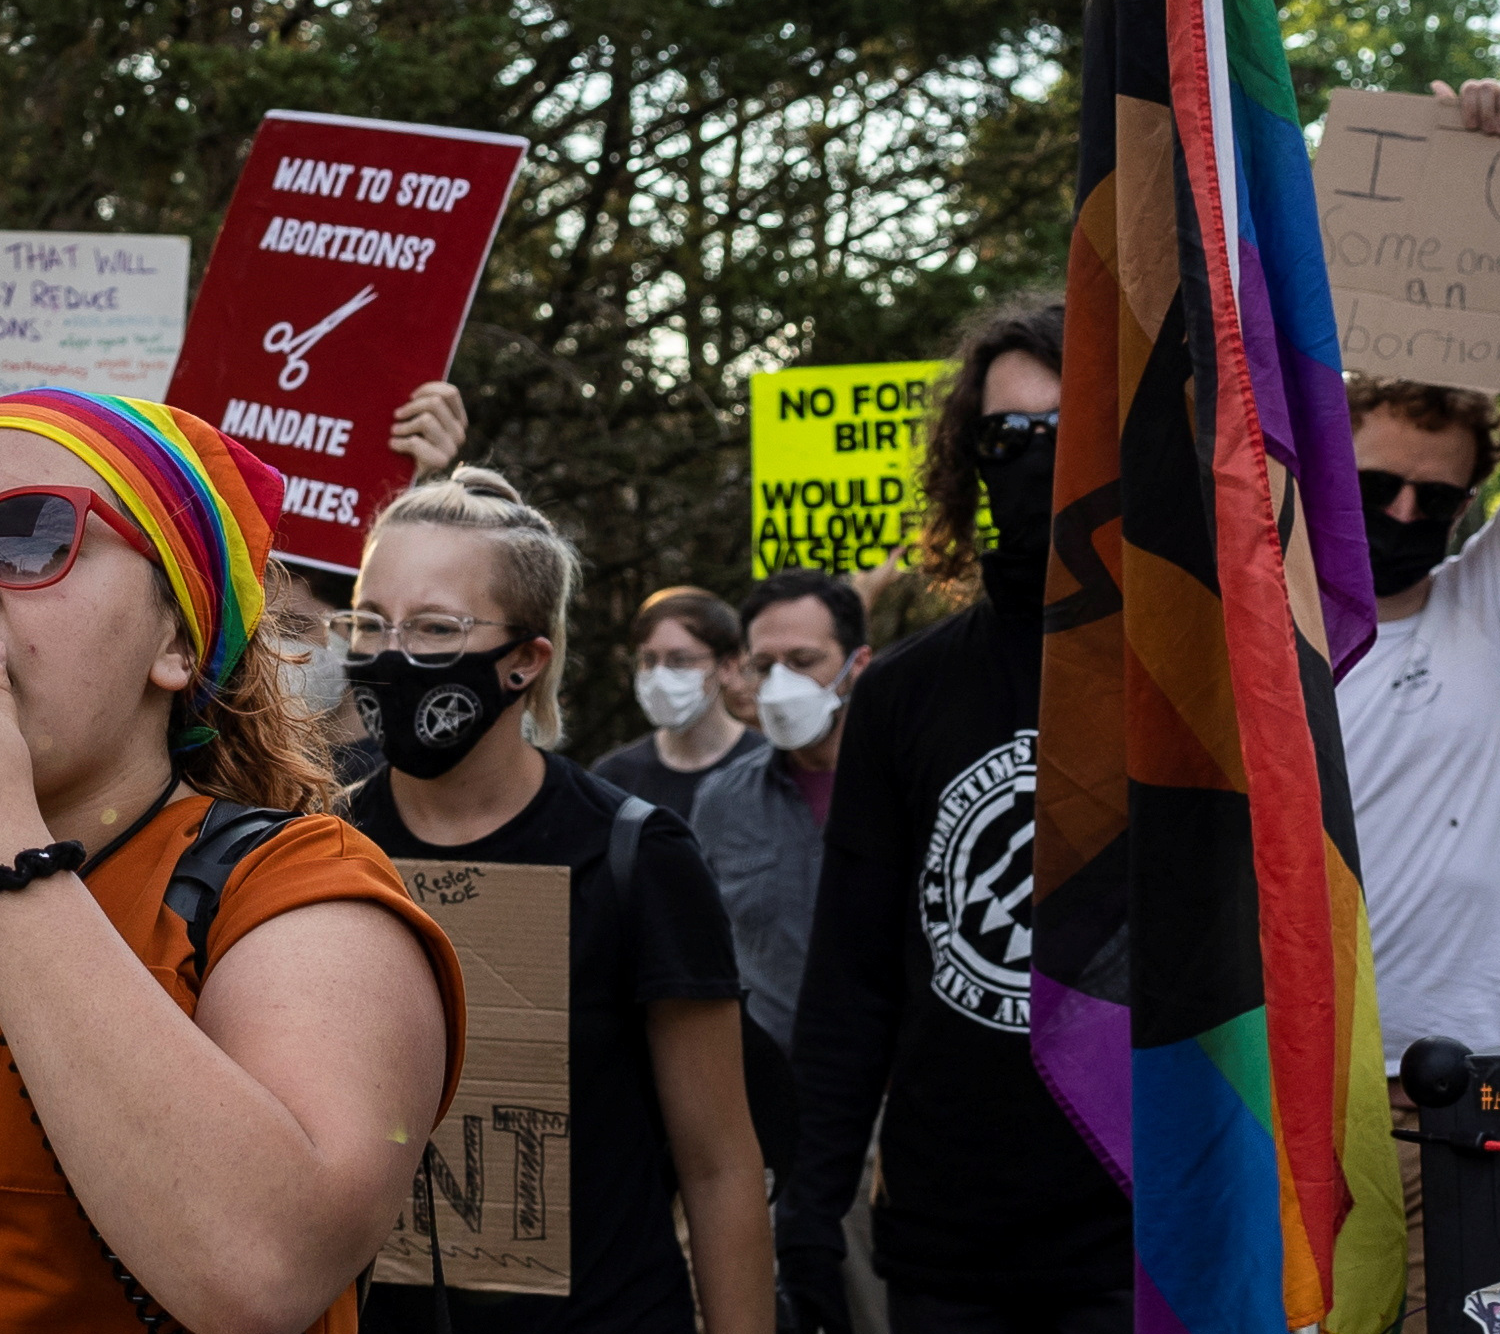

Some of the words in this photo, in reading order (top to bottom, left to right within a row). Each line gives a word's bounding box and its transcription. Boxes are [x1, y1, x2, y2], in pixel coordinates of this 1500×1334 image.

[1335, 126, 1427, 202] I
[272, 156, 355, 199] WANT
[355, 165, 393, 204] TO
[396, 171, 471, 213] STOP
[4, 240, 81, 273] THAT
[93, 246, 159, 276] WILL
[259, 216, 436, 274] ABORTIONS?
[29, 279, 119, 312] REDUCE
[1404, 277, 1467, 311] an
[779, 386, 836, 422] NO
[852, 379, 929, 417] FOR
[220, 398, 354, 457] MANDATE
[834, 418, 926, 454] BIRT
[761, 476, 905, 511] WOULD
[758, 512, 887, 545] ALLOW
[413, 866, 486, 903] Restore
[439, 880, 480, 906] ROE
